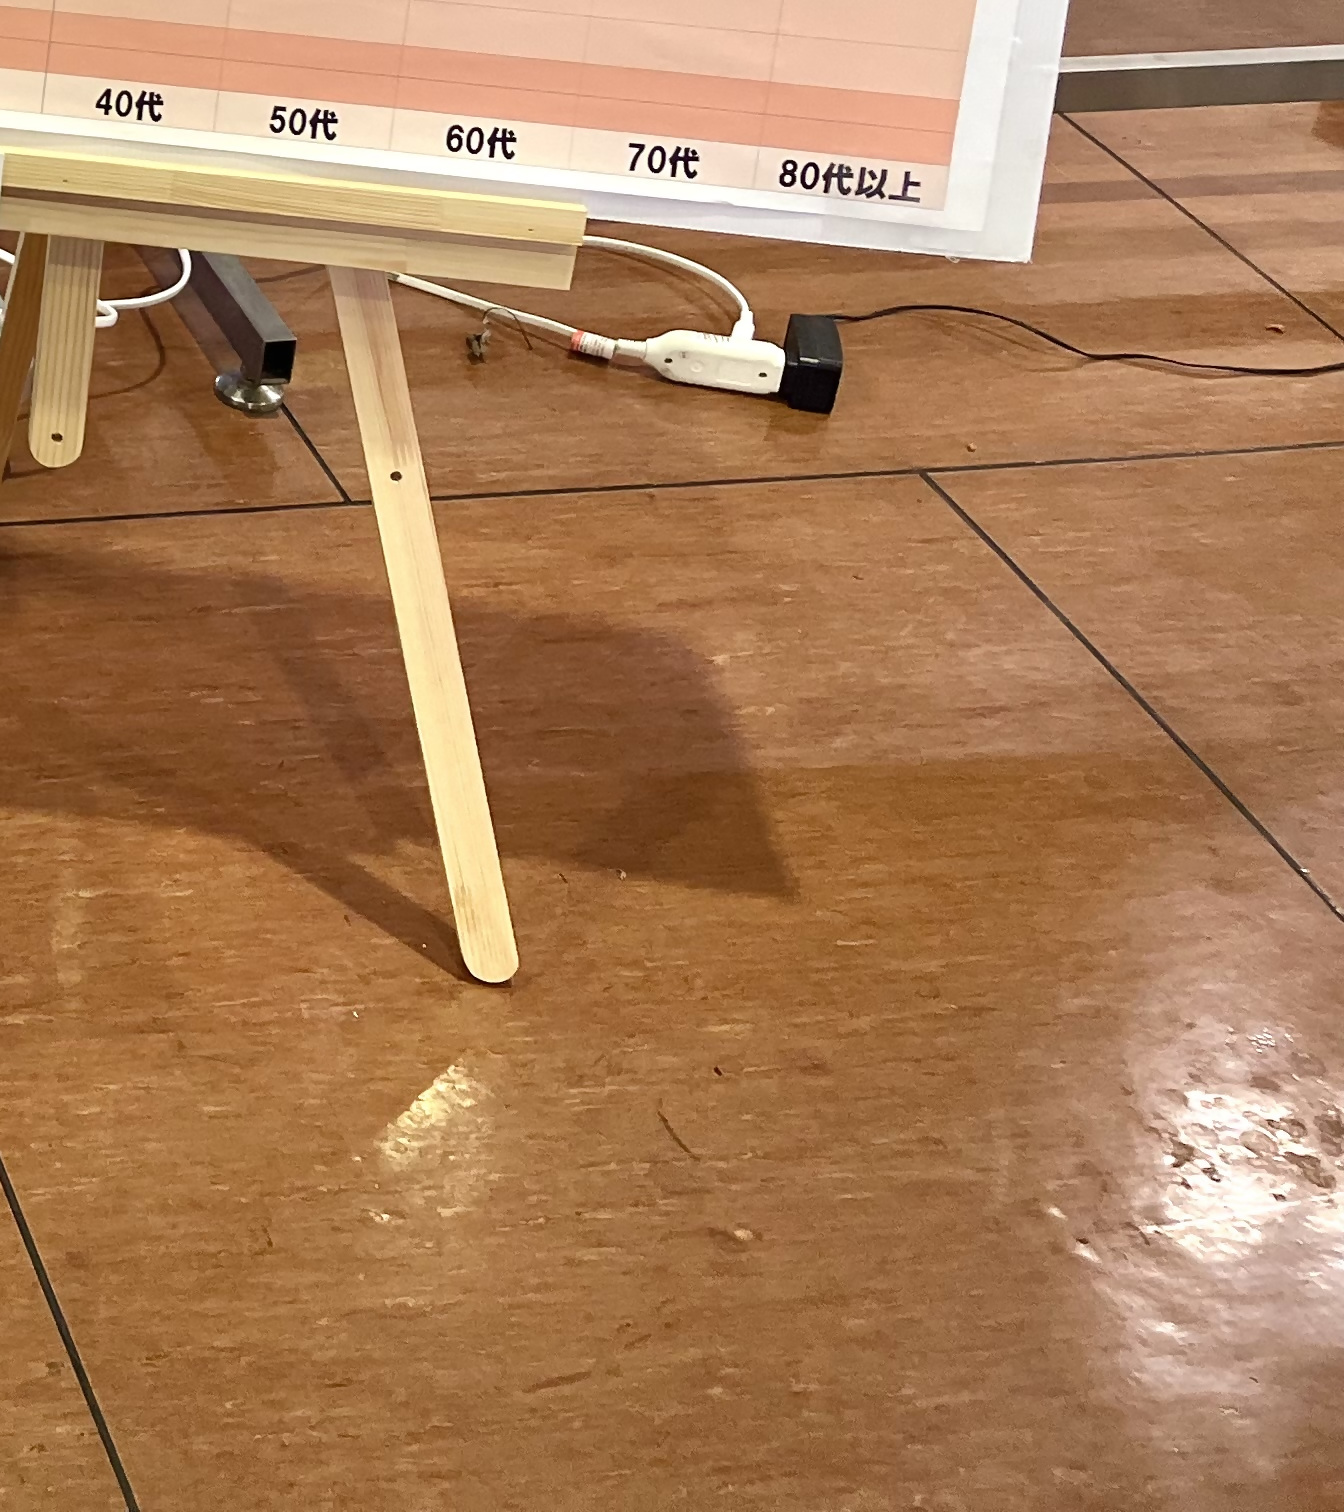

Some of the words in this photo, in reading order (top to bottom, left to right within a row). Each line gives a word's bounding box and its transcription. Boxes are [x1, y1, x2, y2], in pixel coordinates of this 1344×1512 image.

[95, 88, 164, 122] 40代
[268, 105, 339, 142] 50代
[445, 124, 517, 159] 60代
[627, 142, 700, 179] 70代
[778, 158, 922, 203] 80代以上
